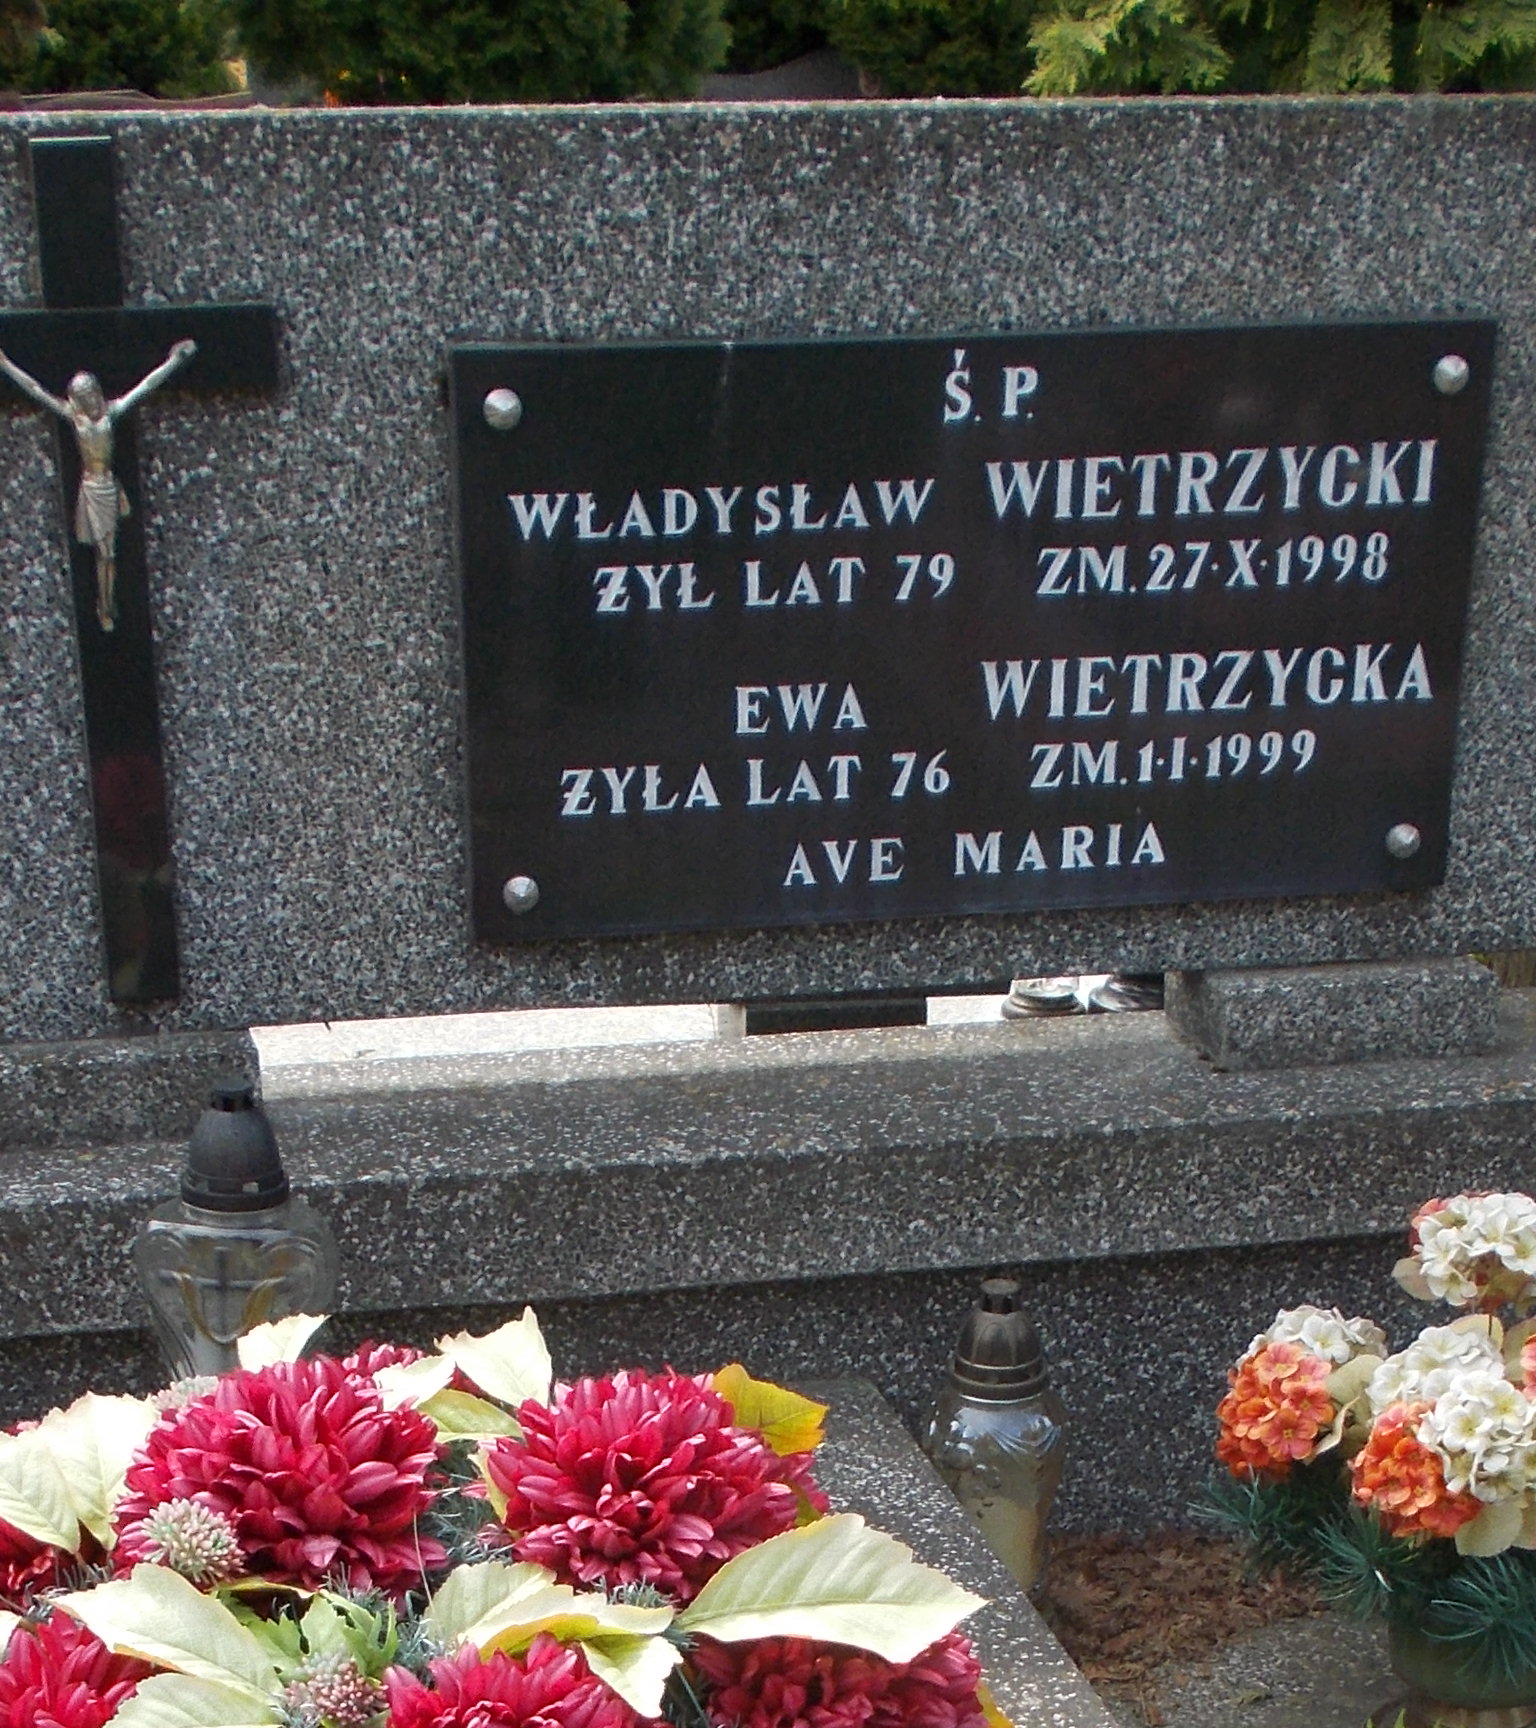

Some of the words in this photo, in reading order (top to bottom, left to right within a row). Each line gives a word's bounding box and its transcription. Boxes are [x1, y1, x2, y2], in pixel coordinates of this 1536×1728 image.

[507, 478, 936, 542] WŁADYSŁAW
[985, 438, 1440, 520] WIETRZYCKI
[744, 555, 866, 607] LAT
[895, 552, 957, 601] 79
[735, 682, 868, 734] EWA
[981, 641, 1435, 721] WIETRZYCKA
[746, 753, 863, 807] LAT
[891, 749, 951, 798] 76
[782, 836, 905, 887] AVE
[953, 822, 1166, 876] MARIA
